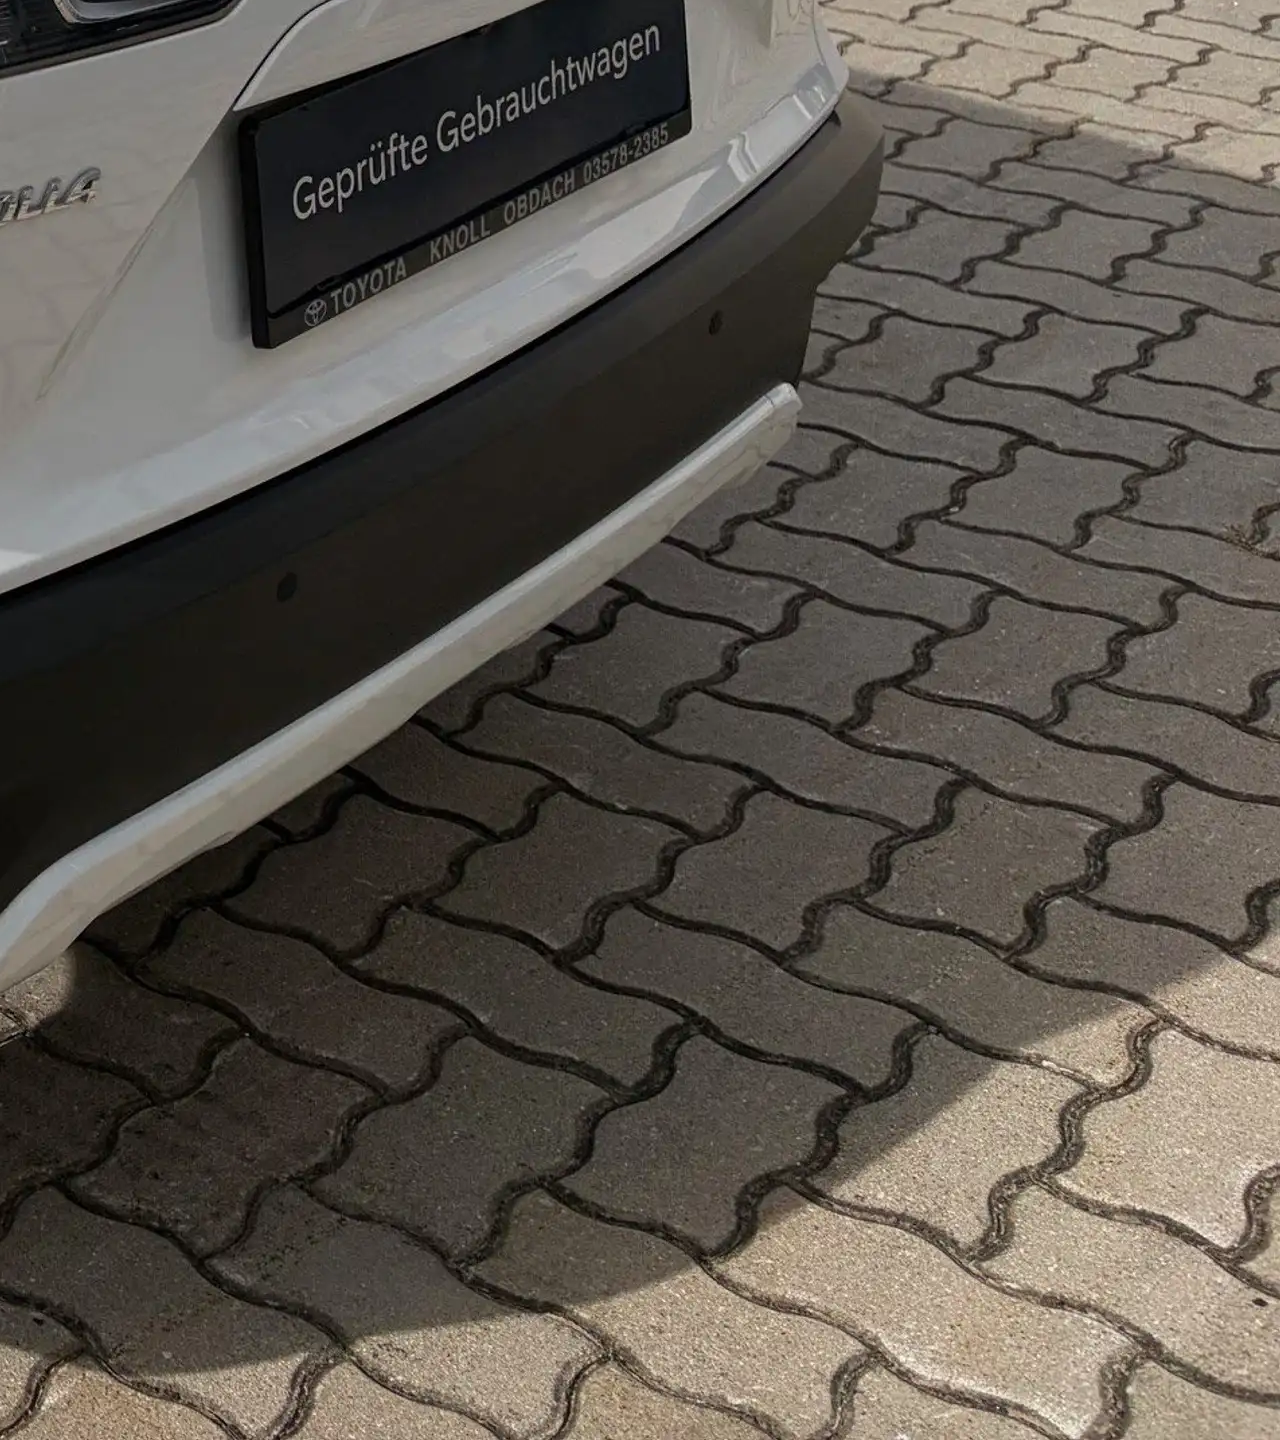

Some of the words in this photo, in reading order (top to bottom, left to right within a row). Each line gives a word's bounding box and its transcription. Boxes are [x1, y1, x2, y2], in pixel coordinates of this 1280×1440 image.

[291, 132, 428, 220] Geprüfte
[436, 23, 661, 153] Gebrauchtwagen
[331, 257, 407, 313] TOYOTA
[429, 212, 491, 263] KNOLL
[503, 172, 576, 225] OBDACH
[583, 122, 670, 185] 03578-2385
